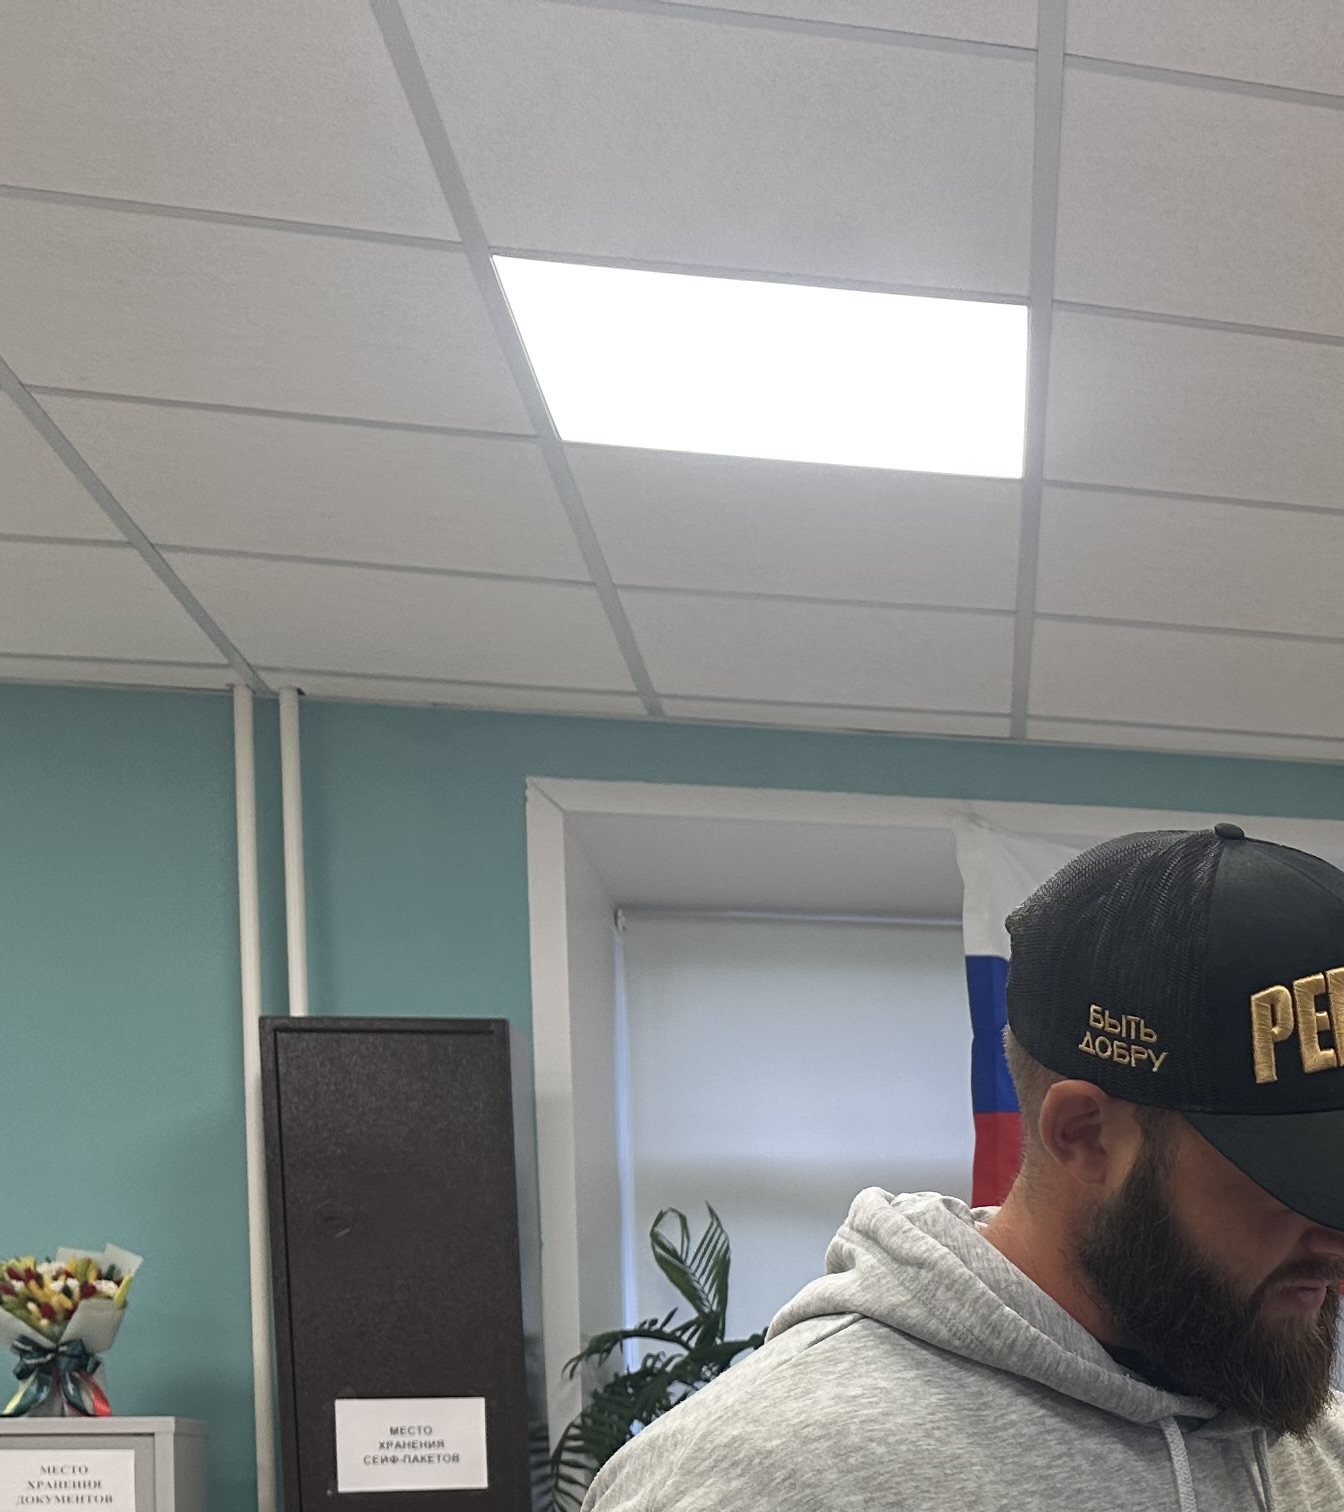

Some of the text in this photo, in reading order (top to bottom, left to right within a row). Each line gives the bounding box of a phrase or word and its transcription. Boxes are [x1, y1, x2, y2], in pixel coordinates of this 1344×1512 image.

[1089, 1004, 1159, 1043] БЫТЬ
[1078, 1031, 1169, 1073] ДОБРУ
[389, 1425, 433, 1436] МЕСТО
[378, 1440, 446, 1450] ХРАНЕНИЯ
[362, 1453, 461, 1466] СЕЙФ-ПАКЕТОВ
[40, 1465, 88, 1474] МЕСТО
